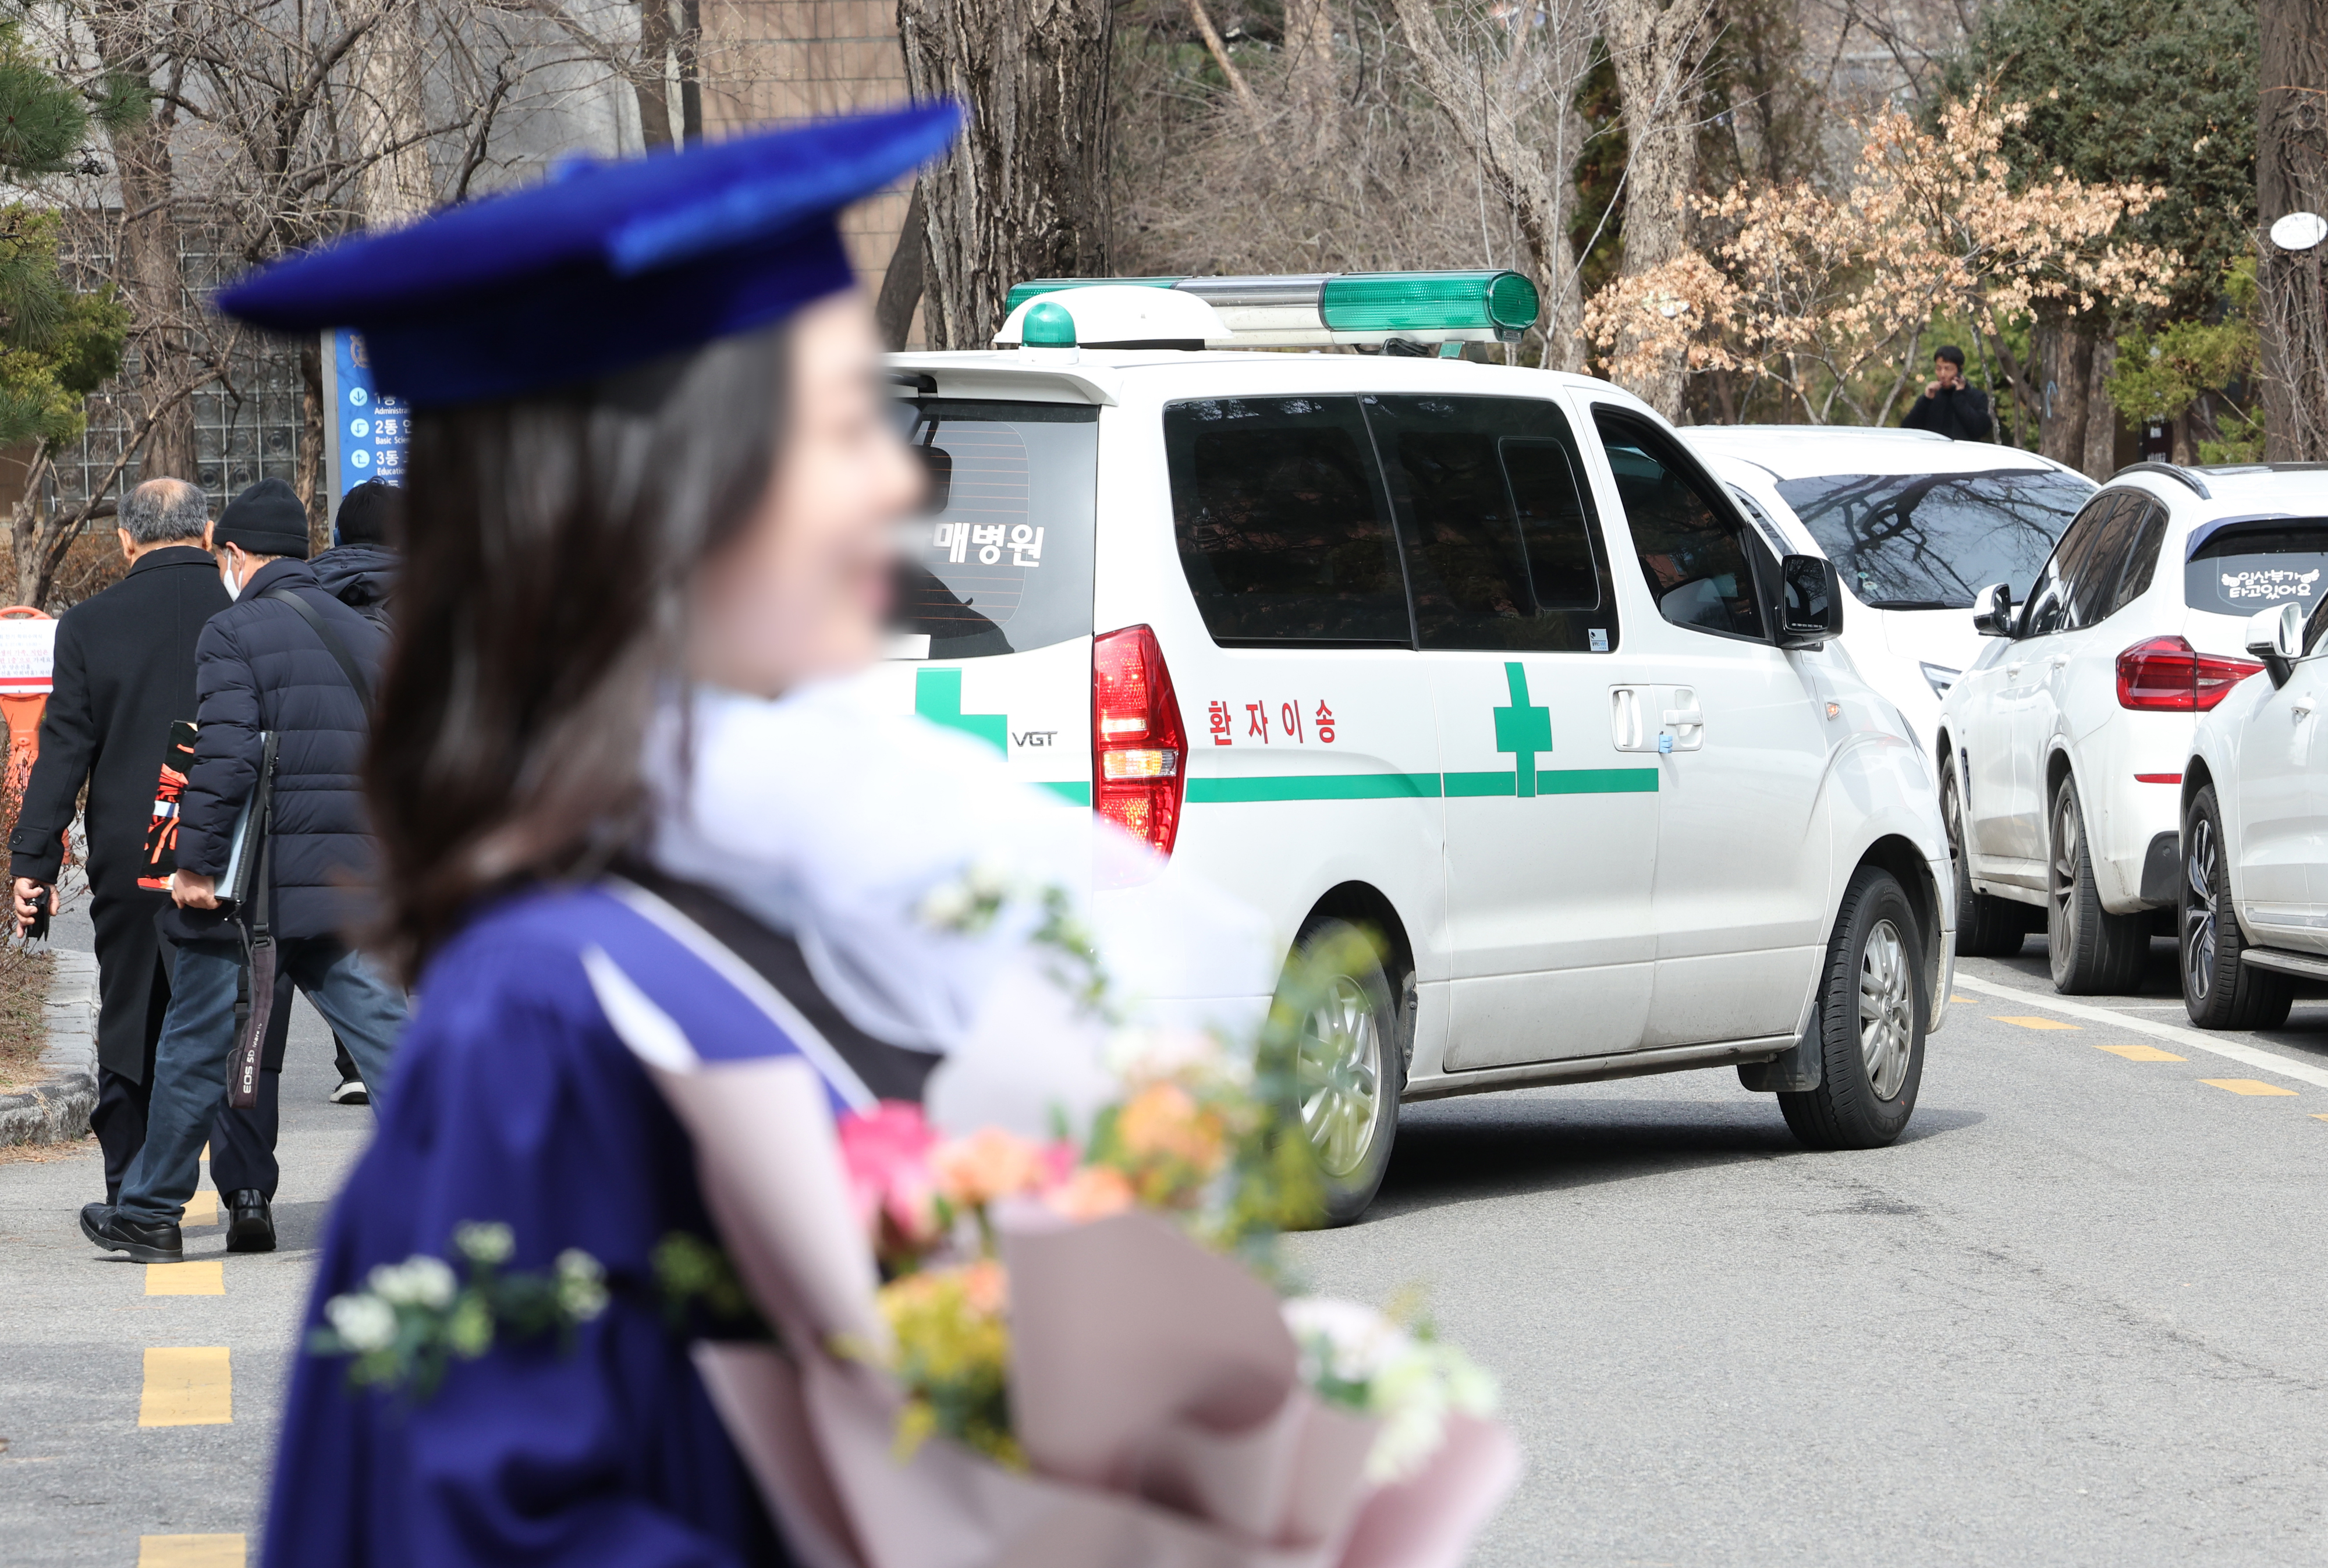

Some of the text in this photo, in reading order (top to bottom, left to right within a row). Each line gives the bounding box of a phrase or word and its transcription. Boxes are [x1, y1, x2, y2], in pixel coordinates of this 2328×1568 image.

[375, 419, 398, 435] 2동
[375, 437, 392, 445] Basic
[376, 450, 399, 466] 3동
[2238, 569, 2302, 586] 임산부가
[2230, 583, 2311, 599] 타고있어요
[1012, 731, 1058, 747] VGT
[246, 1049, 255, 1063] 5D
[243, 1066, 253, 1094] EOS
